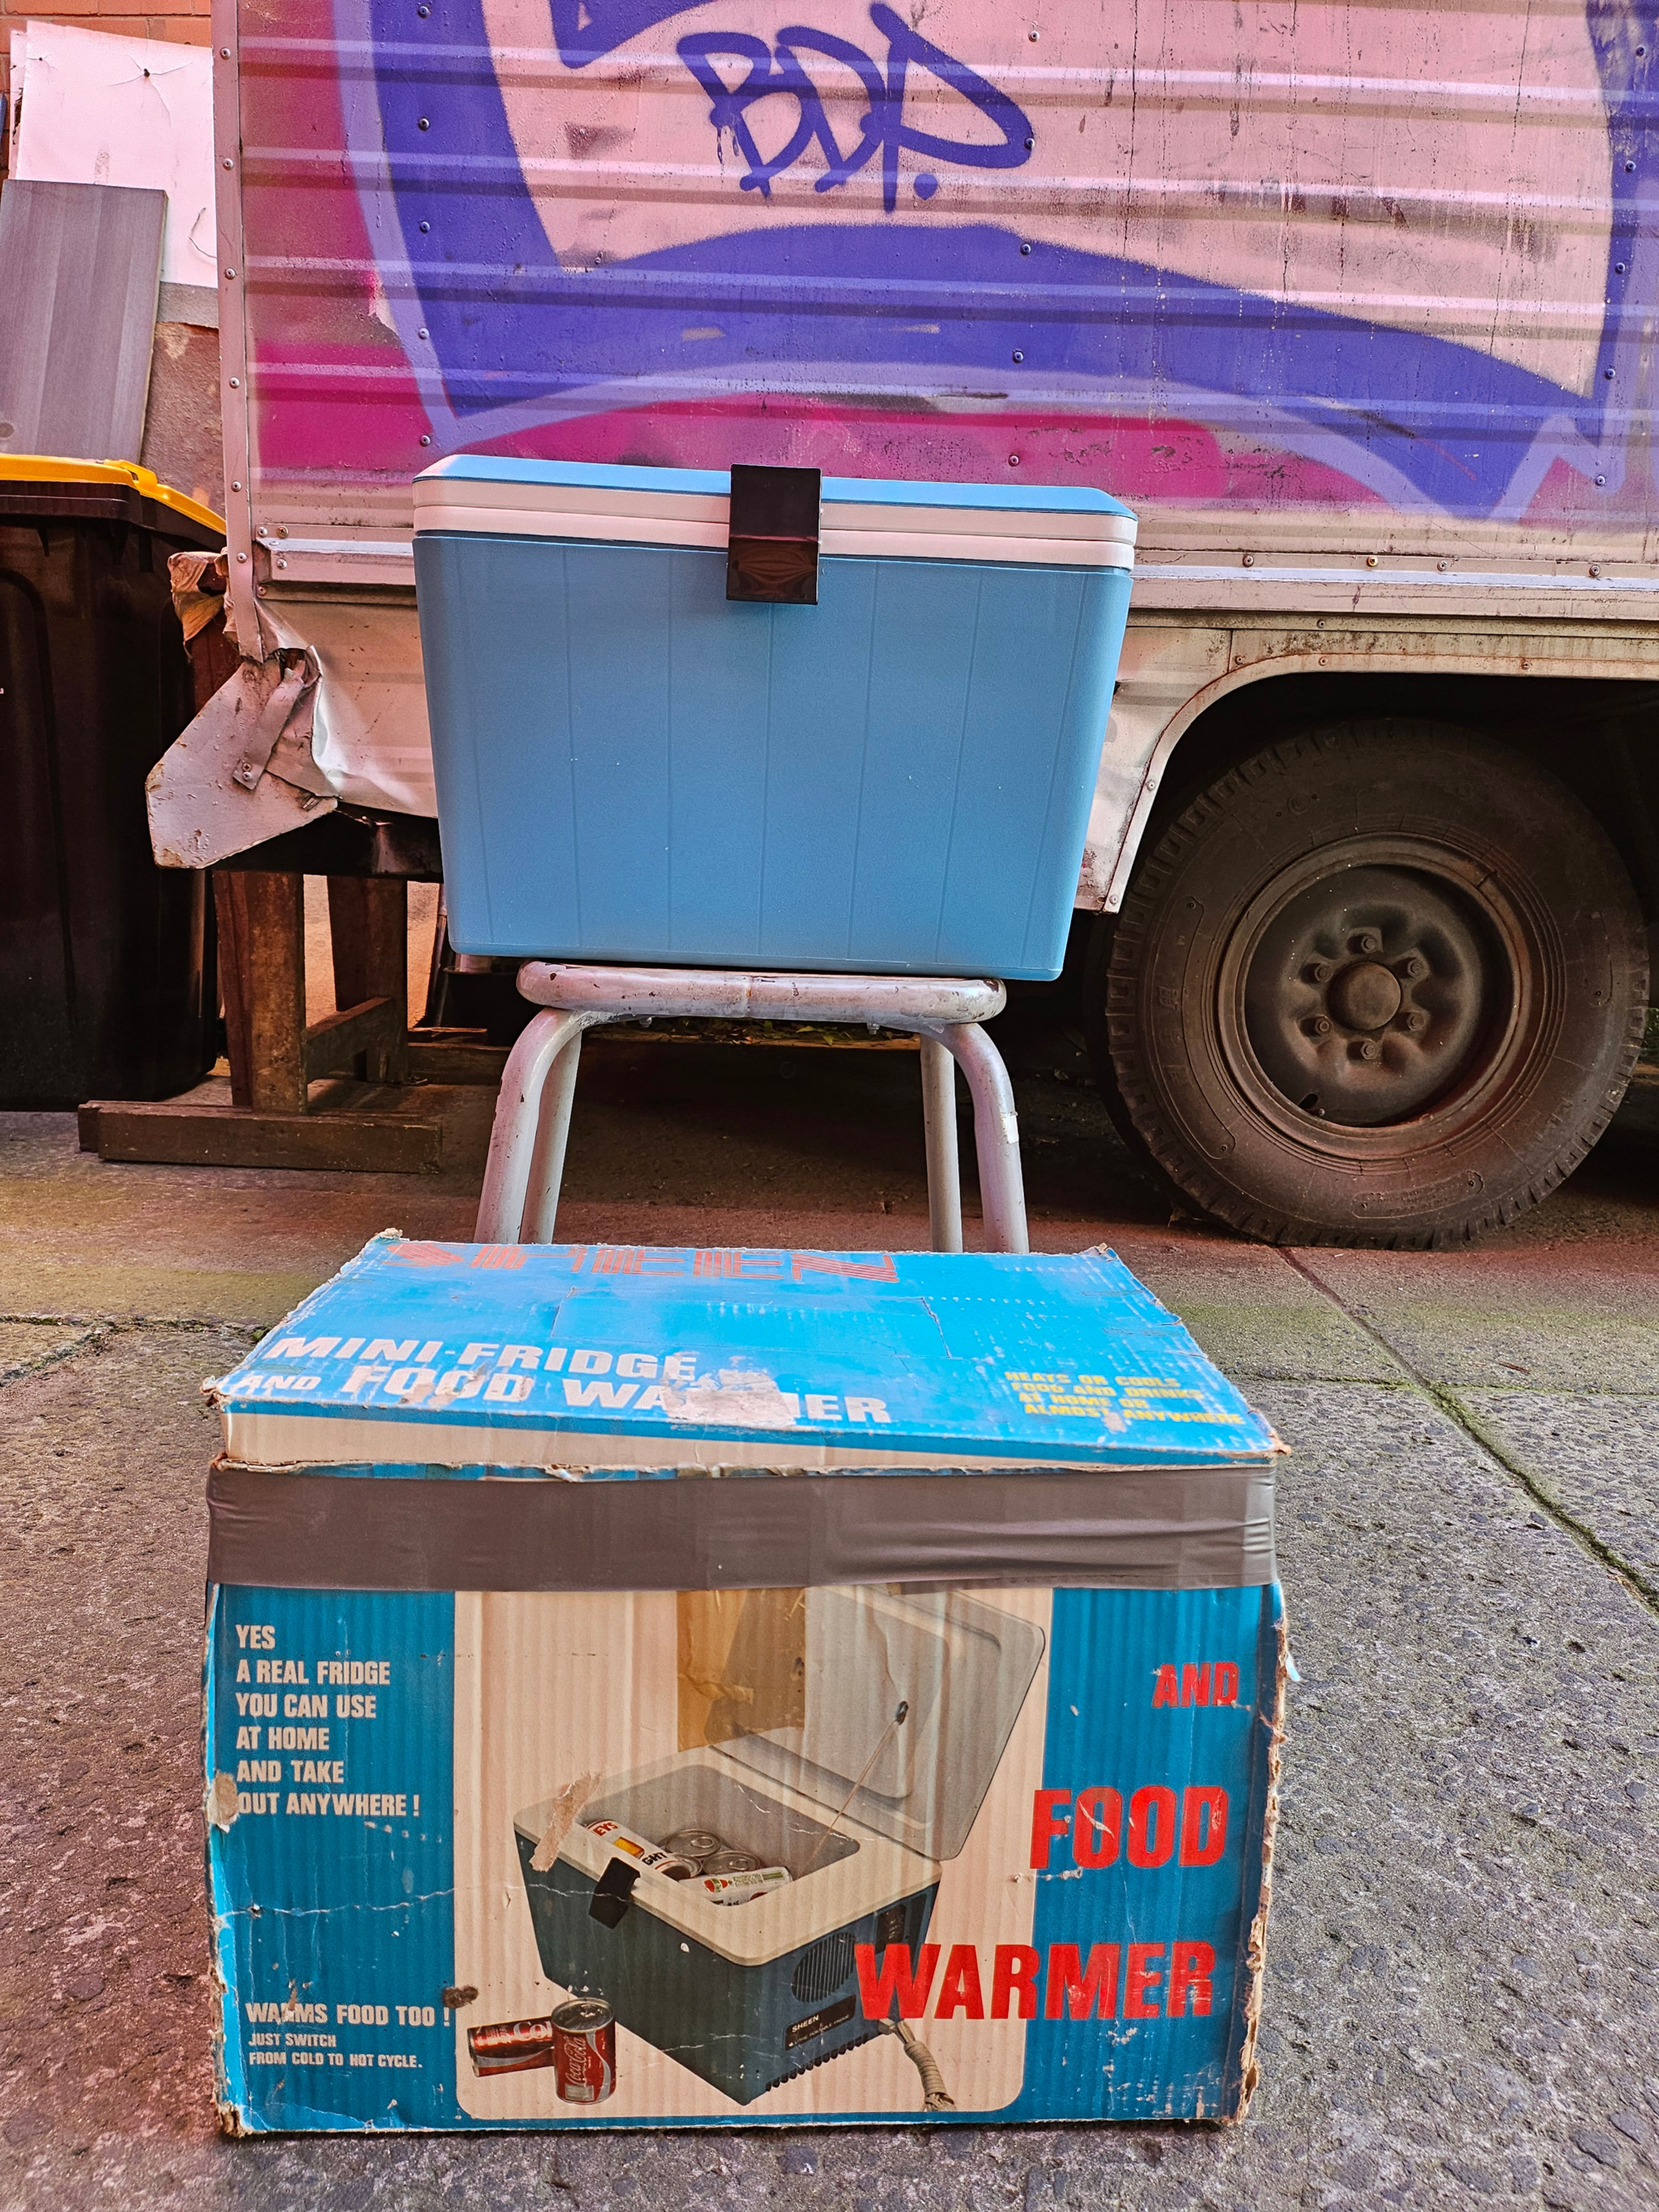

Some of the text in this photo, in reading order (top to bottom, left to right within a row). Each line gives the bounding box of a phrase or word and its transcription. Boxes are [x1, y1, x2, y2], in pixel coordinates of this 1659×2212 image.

[262, 1337, 697, 1381] MINI-FRIDGE
[1004, 1371, 1181, 1387] HEATS OR COOLS
[1011, 1382, 1204, 1399] FOOD AND DRINKS
[234, 1365, 892, 1423] AND FOOD WAER
[1019, 1393, 1149, 1409] AT HOME OR
[1122, 1408, 1246, 1425] ANYWHERE
[236, 1624, 275, 1650] YES
[236, 1659, 390, 1685] A REAL FRIDGE
[1152, 1662, 1239, 1708] AND
[236, 1692, 377, 1719] YOU CAN USE
[236, 1726, 330, 1750] AT HOME
[236, 1760, 345, 1784] AND TAKE
[238, 1792, 280, 1814] OUT
[286, 1793, 406, 1816] ANYWHERE
[1030, 1786, 1228, 1870] FOOD
[854, 1941, 1215, 2020] WARMER
[337, 2004, 389, 2026] FOOD
[396, 2006, 436, 2026] TOO
[791, 2014, 819, 2033] SHEEN
[248, 2033, 336, 2047] JUST SWITCH
[249, 2052, 423, 2068] FROM COLD TO HOT CYCLE.
